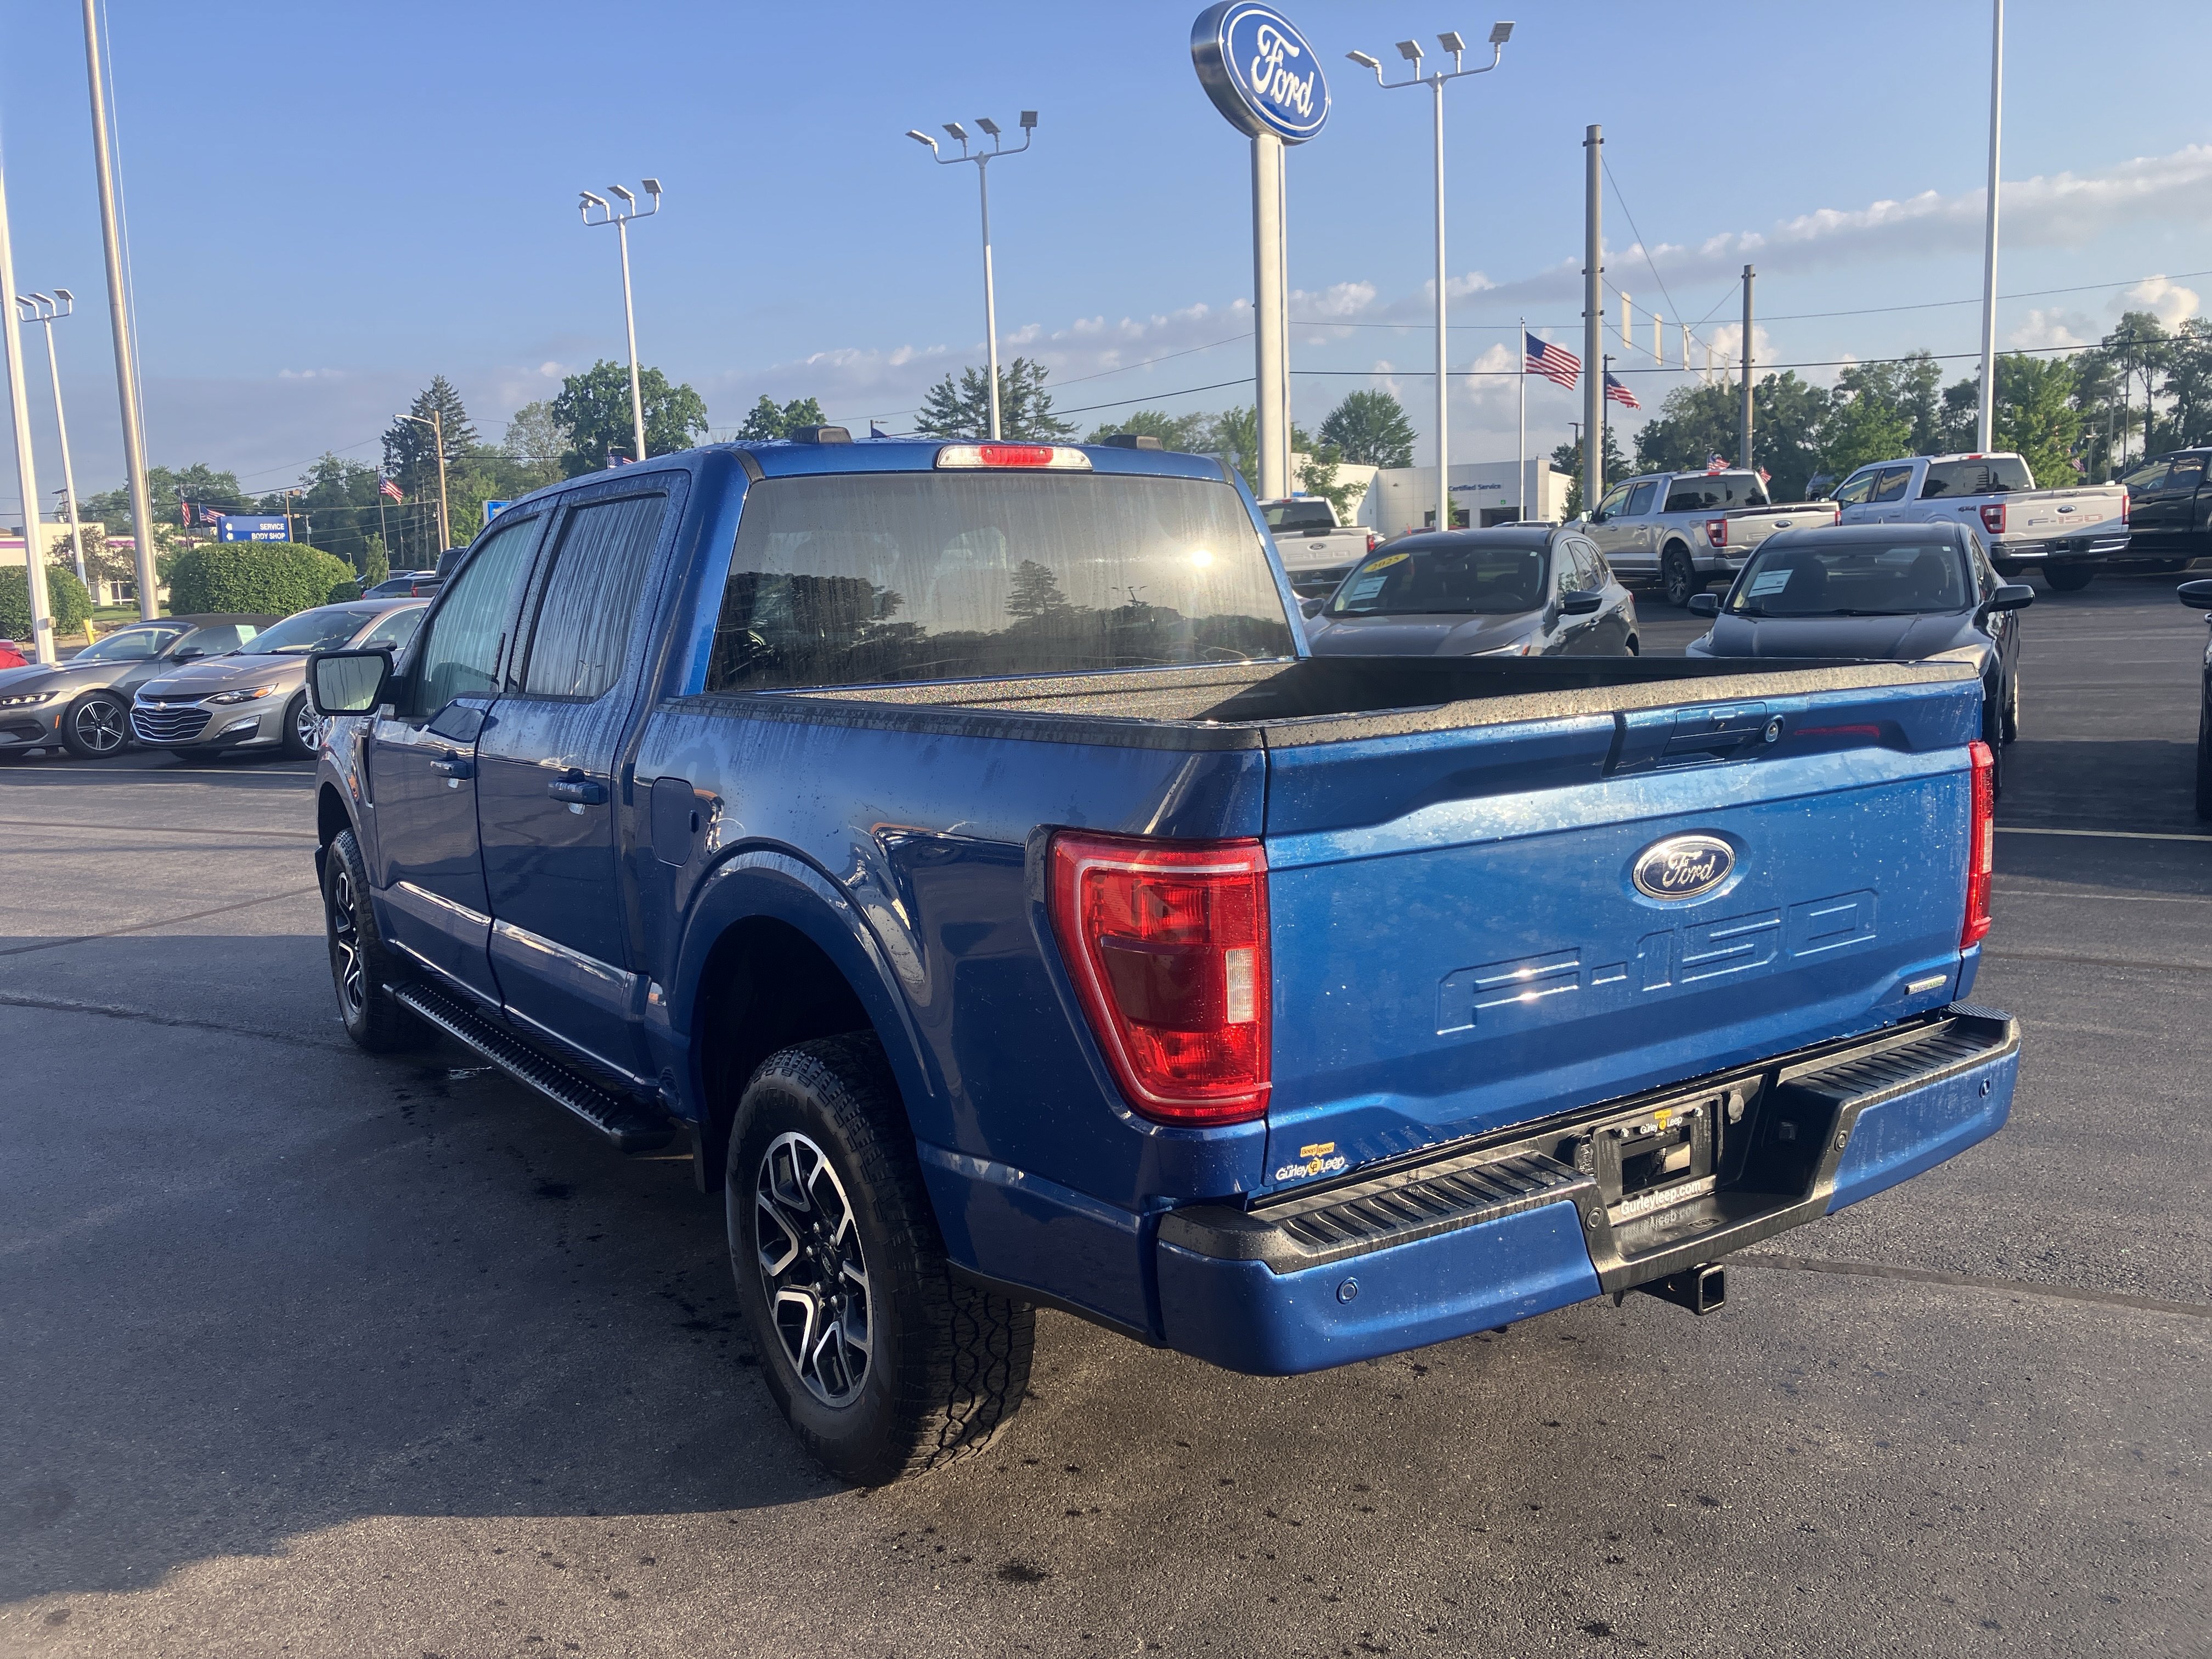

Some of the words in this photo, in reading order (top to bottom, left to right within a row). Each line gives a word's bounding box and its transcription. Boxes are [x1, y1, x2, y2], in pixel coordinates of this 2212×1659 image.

[1251, 24, 1314, 117] Ford
[2028, 514, 2103, 526] F-150
[1372, 556, 1399, 570] 2025
[1662, 850, 1717, 888] Ford
[1436, 888, 1881, 1036] F-150
[1667, 1116, 1683, 1127] Leep
[1276, 1164, 1309, 1181] Gurley
[1321, 1156, 1345, 1170] Leep
[1621, 1181, 1701, 1215] Gurleyleep.com
